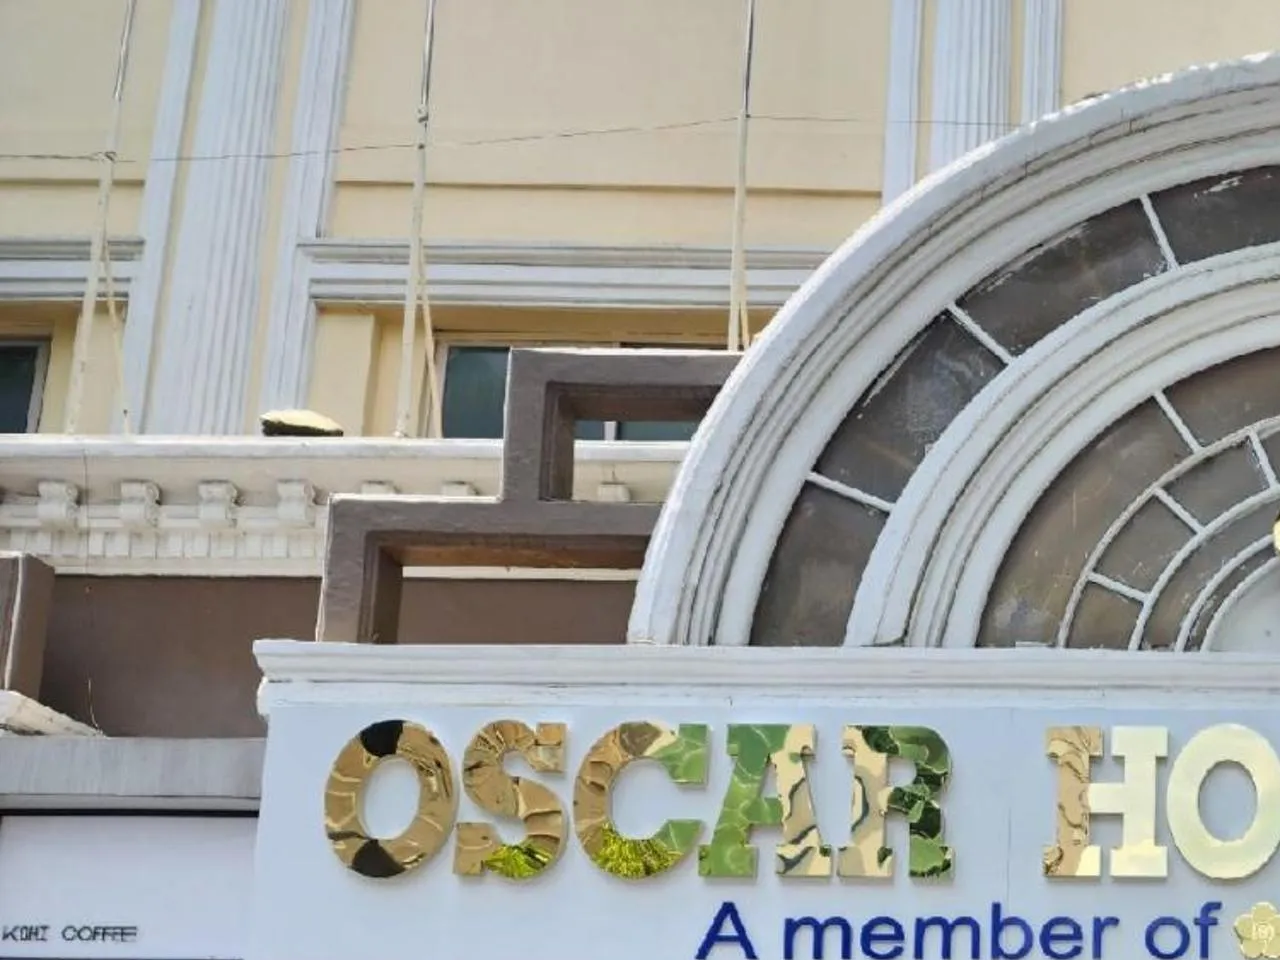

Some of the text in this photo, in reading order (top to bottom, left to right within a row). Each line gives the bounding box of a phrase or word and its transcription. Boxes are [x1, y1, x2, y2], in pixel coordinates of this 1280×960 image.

[324, 719, 955, 879] OSCAR
[2, 925, 138, 942] KOHI COFFEE
[695, 902, 757, 960] A
[783, 900, 1119, 960] member
[1145, 901, 1222, 960] of
